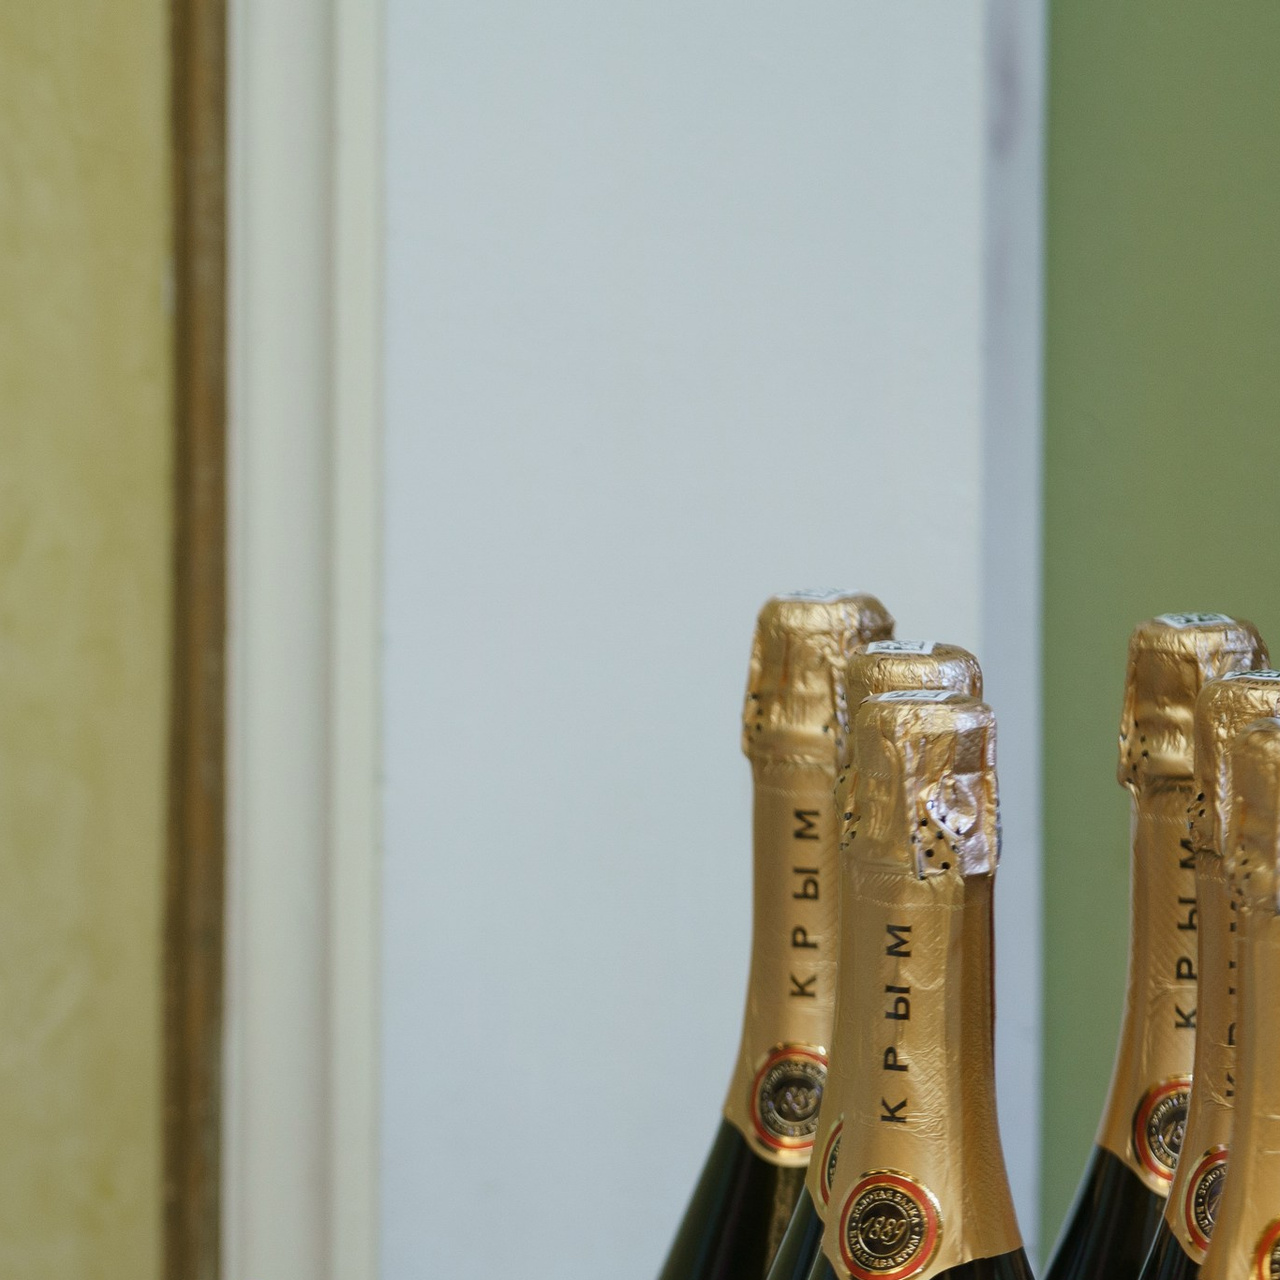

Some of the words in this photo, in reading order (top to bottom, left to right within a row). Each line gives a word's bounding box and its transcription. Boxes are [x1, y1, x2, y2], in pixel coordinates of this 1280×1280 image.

[789, 808, 820, 998] КРЫМ
[1175, 837, 1198, 1030] КРЫМ
[880, 923, 912, 1124] КРЫМ
[861, 1215, 908, 1246] 1889
